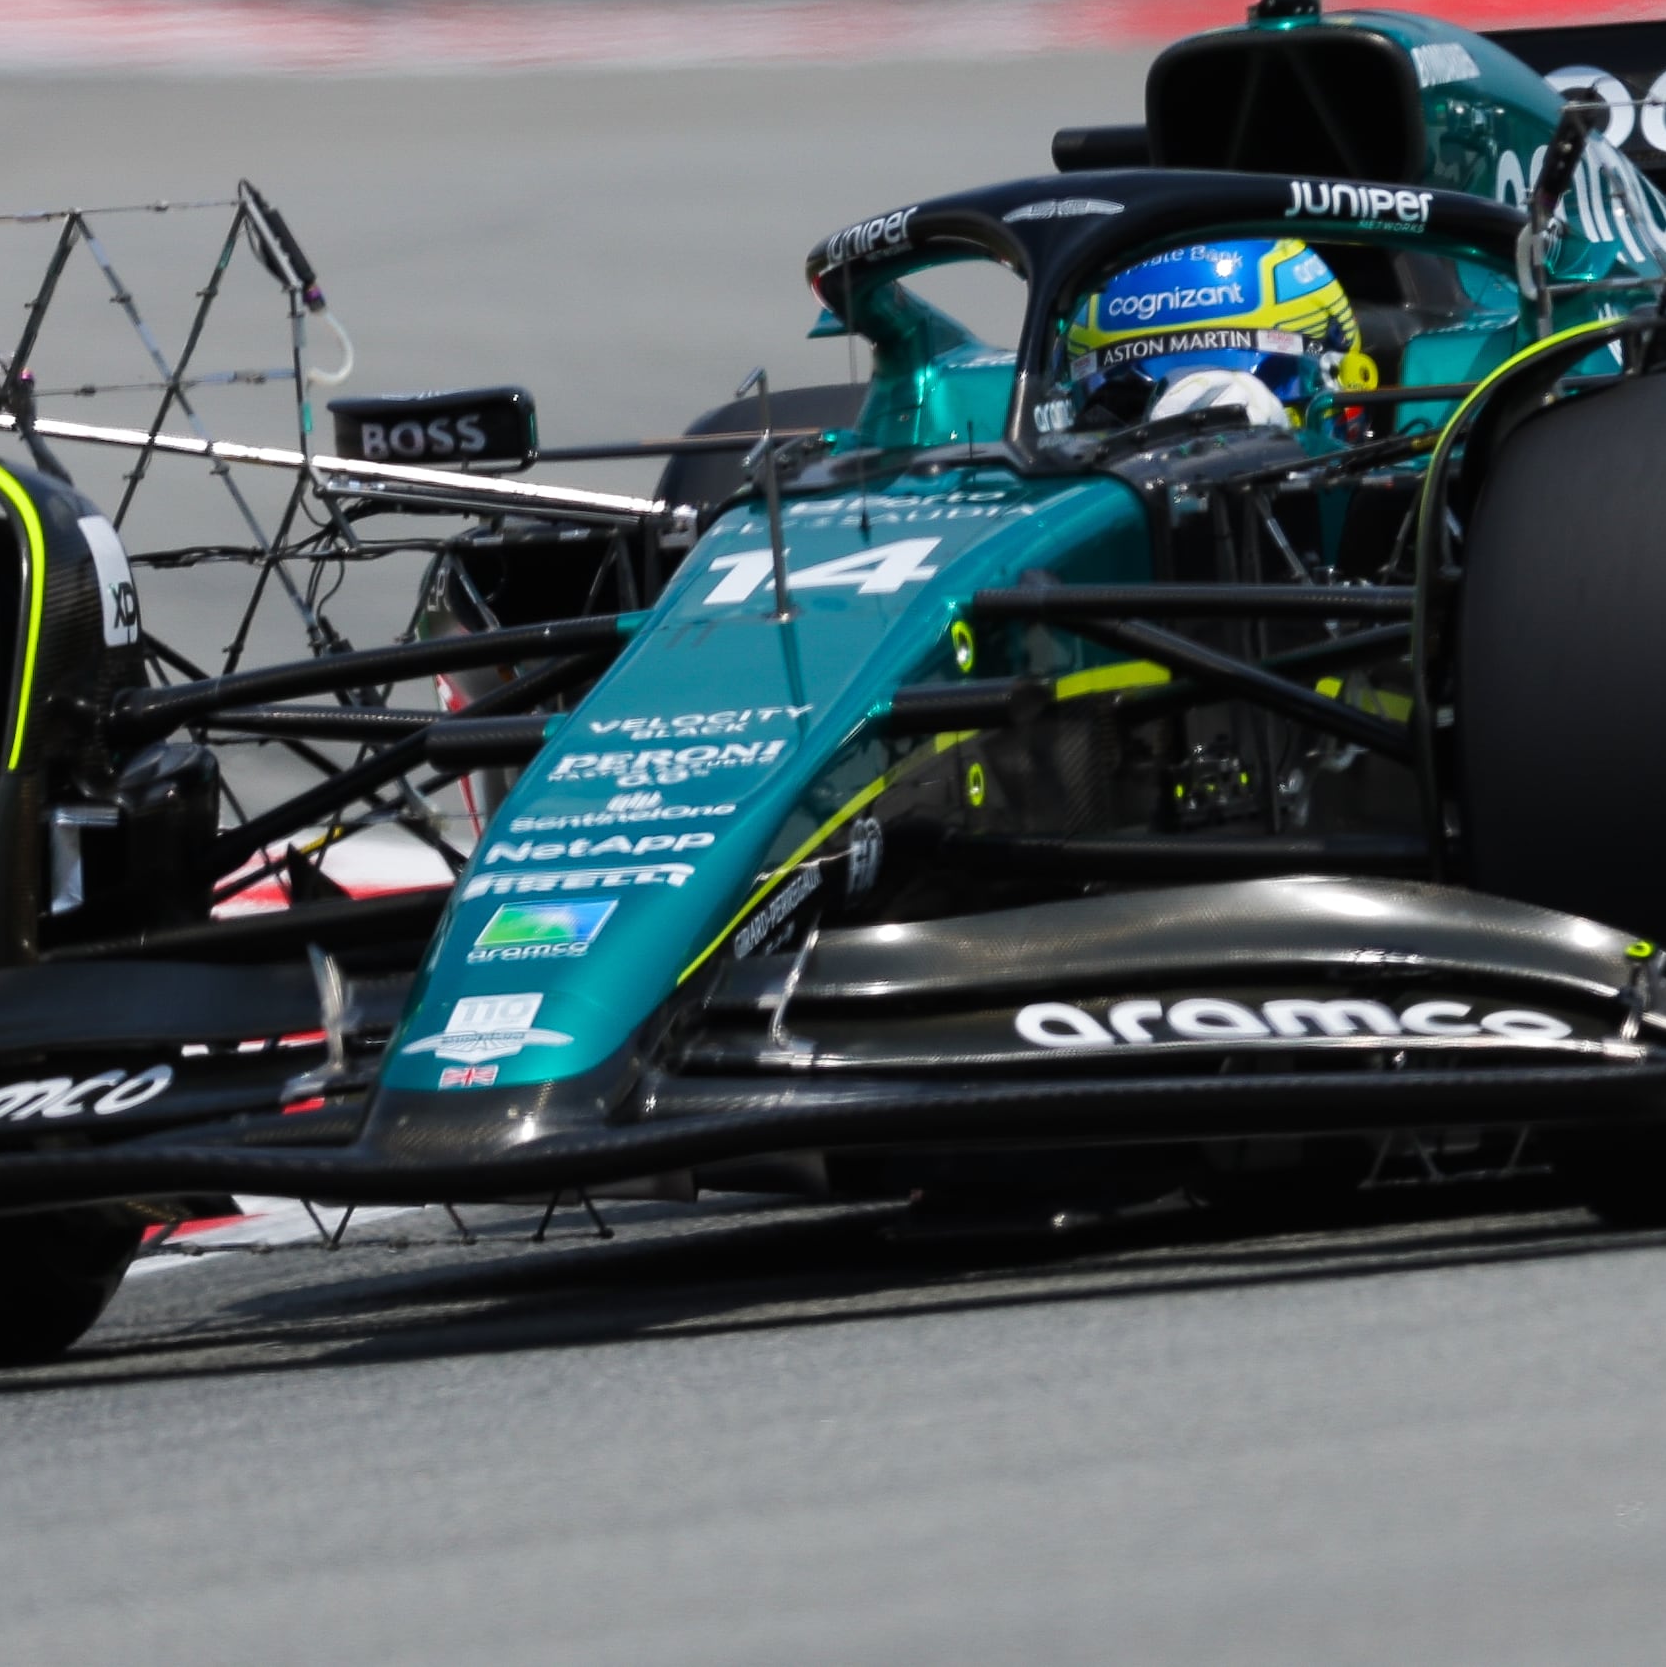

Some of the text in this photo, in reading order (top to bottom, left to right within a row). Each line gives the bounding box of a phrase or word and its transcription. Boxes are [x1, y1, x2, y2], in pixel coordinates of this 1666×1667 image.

[1109, 282, 1245, 320] cognizant
[1103, 336, 1164, 366] ASTON
[1169, 329, 1252, 353] MARTIN
[361, 413, 487, 460] BOSS
[702, 536, 944, 606] 14
[589, 703, 814, 734] VELOCITY
[550, 738, 789, 776] PERONI
[484, 832, 716, 865] NetApp
[466, 940, 593, 965] aramco
[1014, 997, 1574, 1048] aramco
